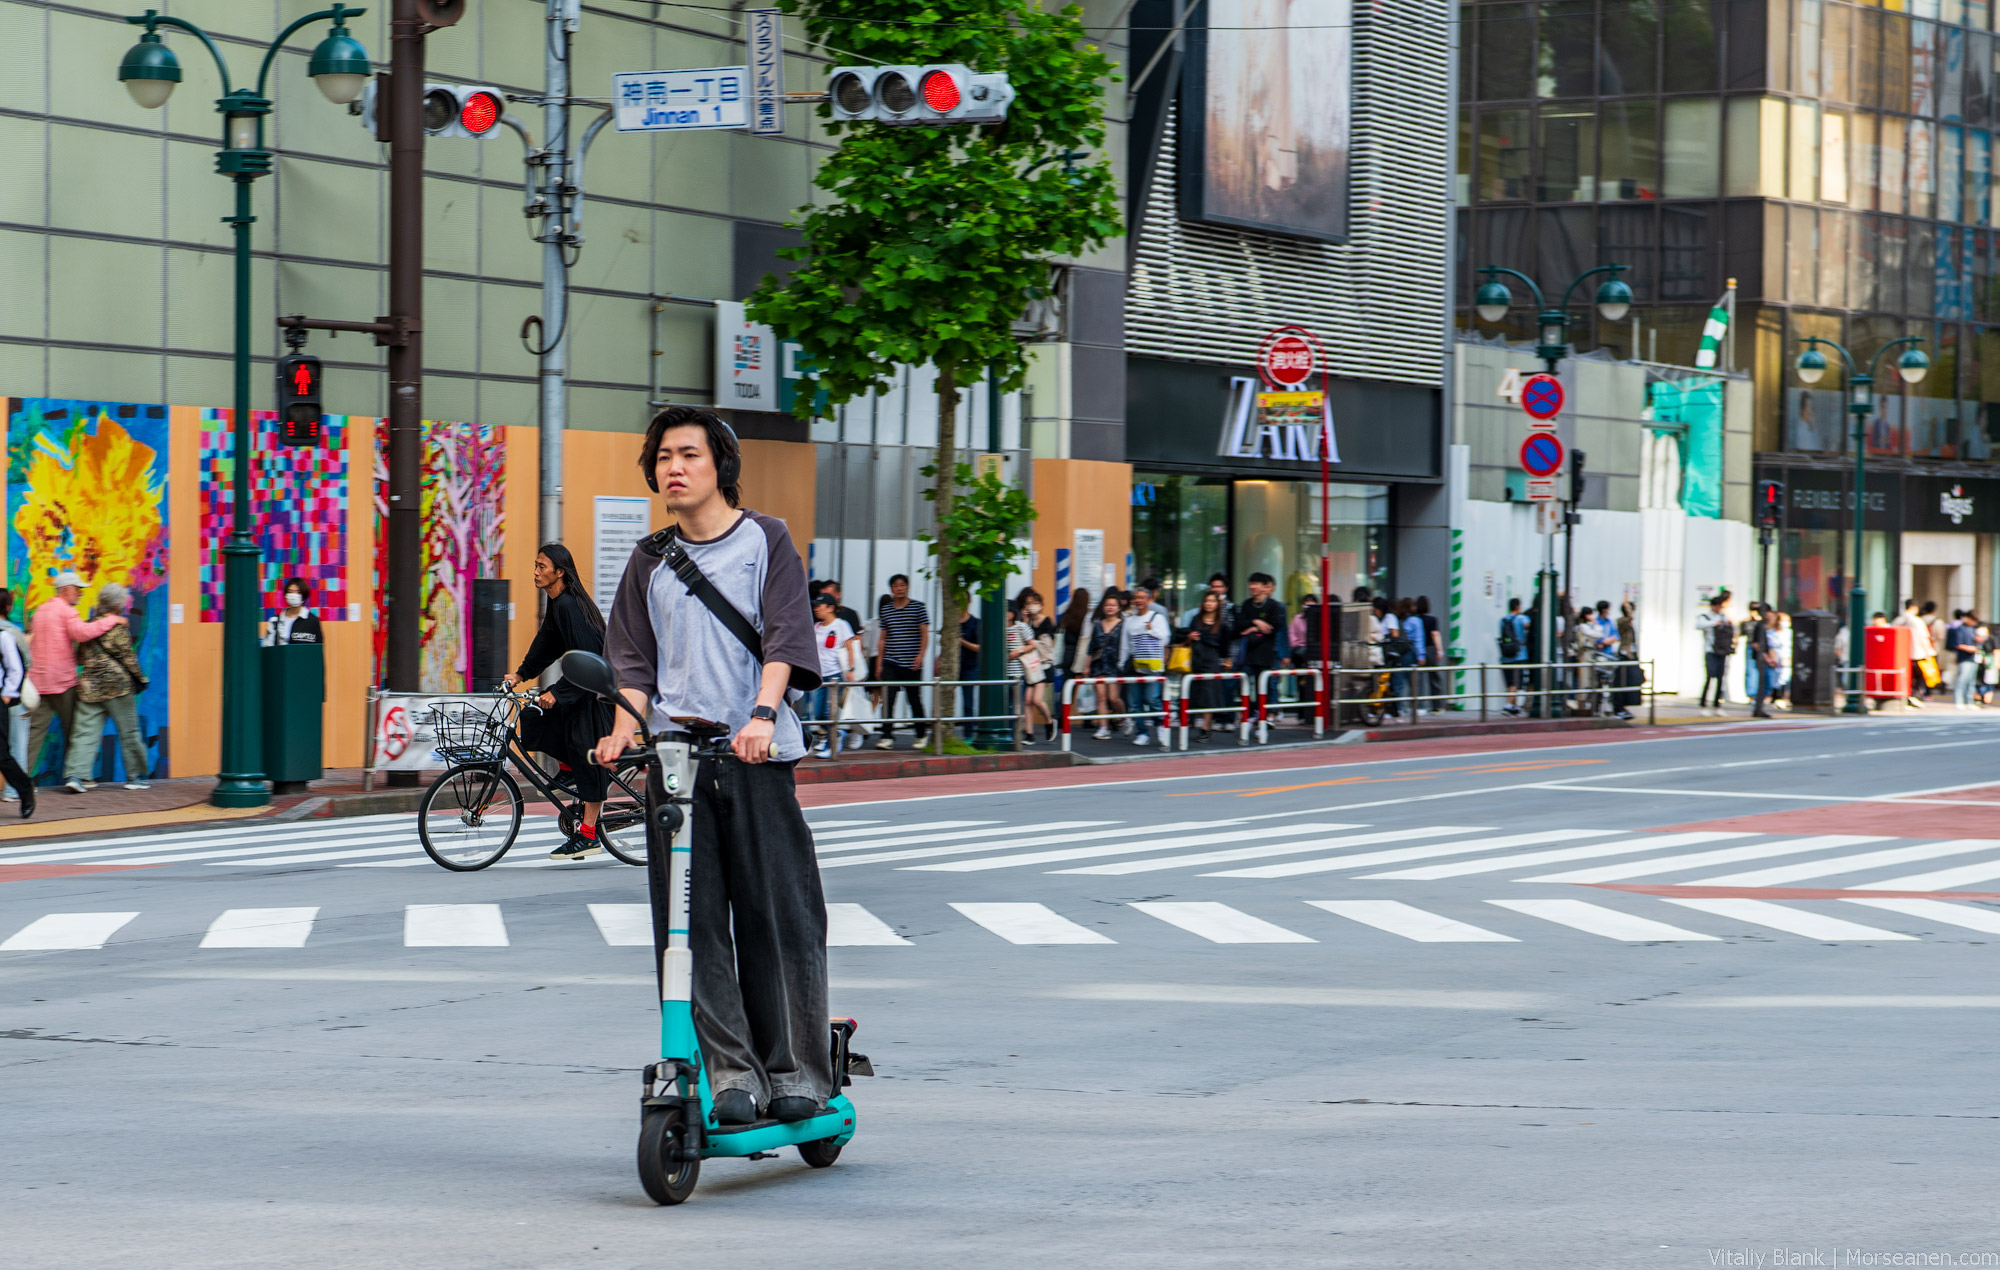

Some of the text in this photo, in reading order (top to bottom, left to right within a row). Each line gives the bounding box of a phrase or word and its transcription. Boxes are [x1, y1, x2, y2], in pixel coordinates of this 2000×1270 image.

[756, 13, 776, 129] スクランブル交差点
[621, 77, 739, 106] 神南一丁目
[642, 105, 722, 126] Jinnan 1
